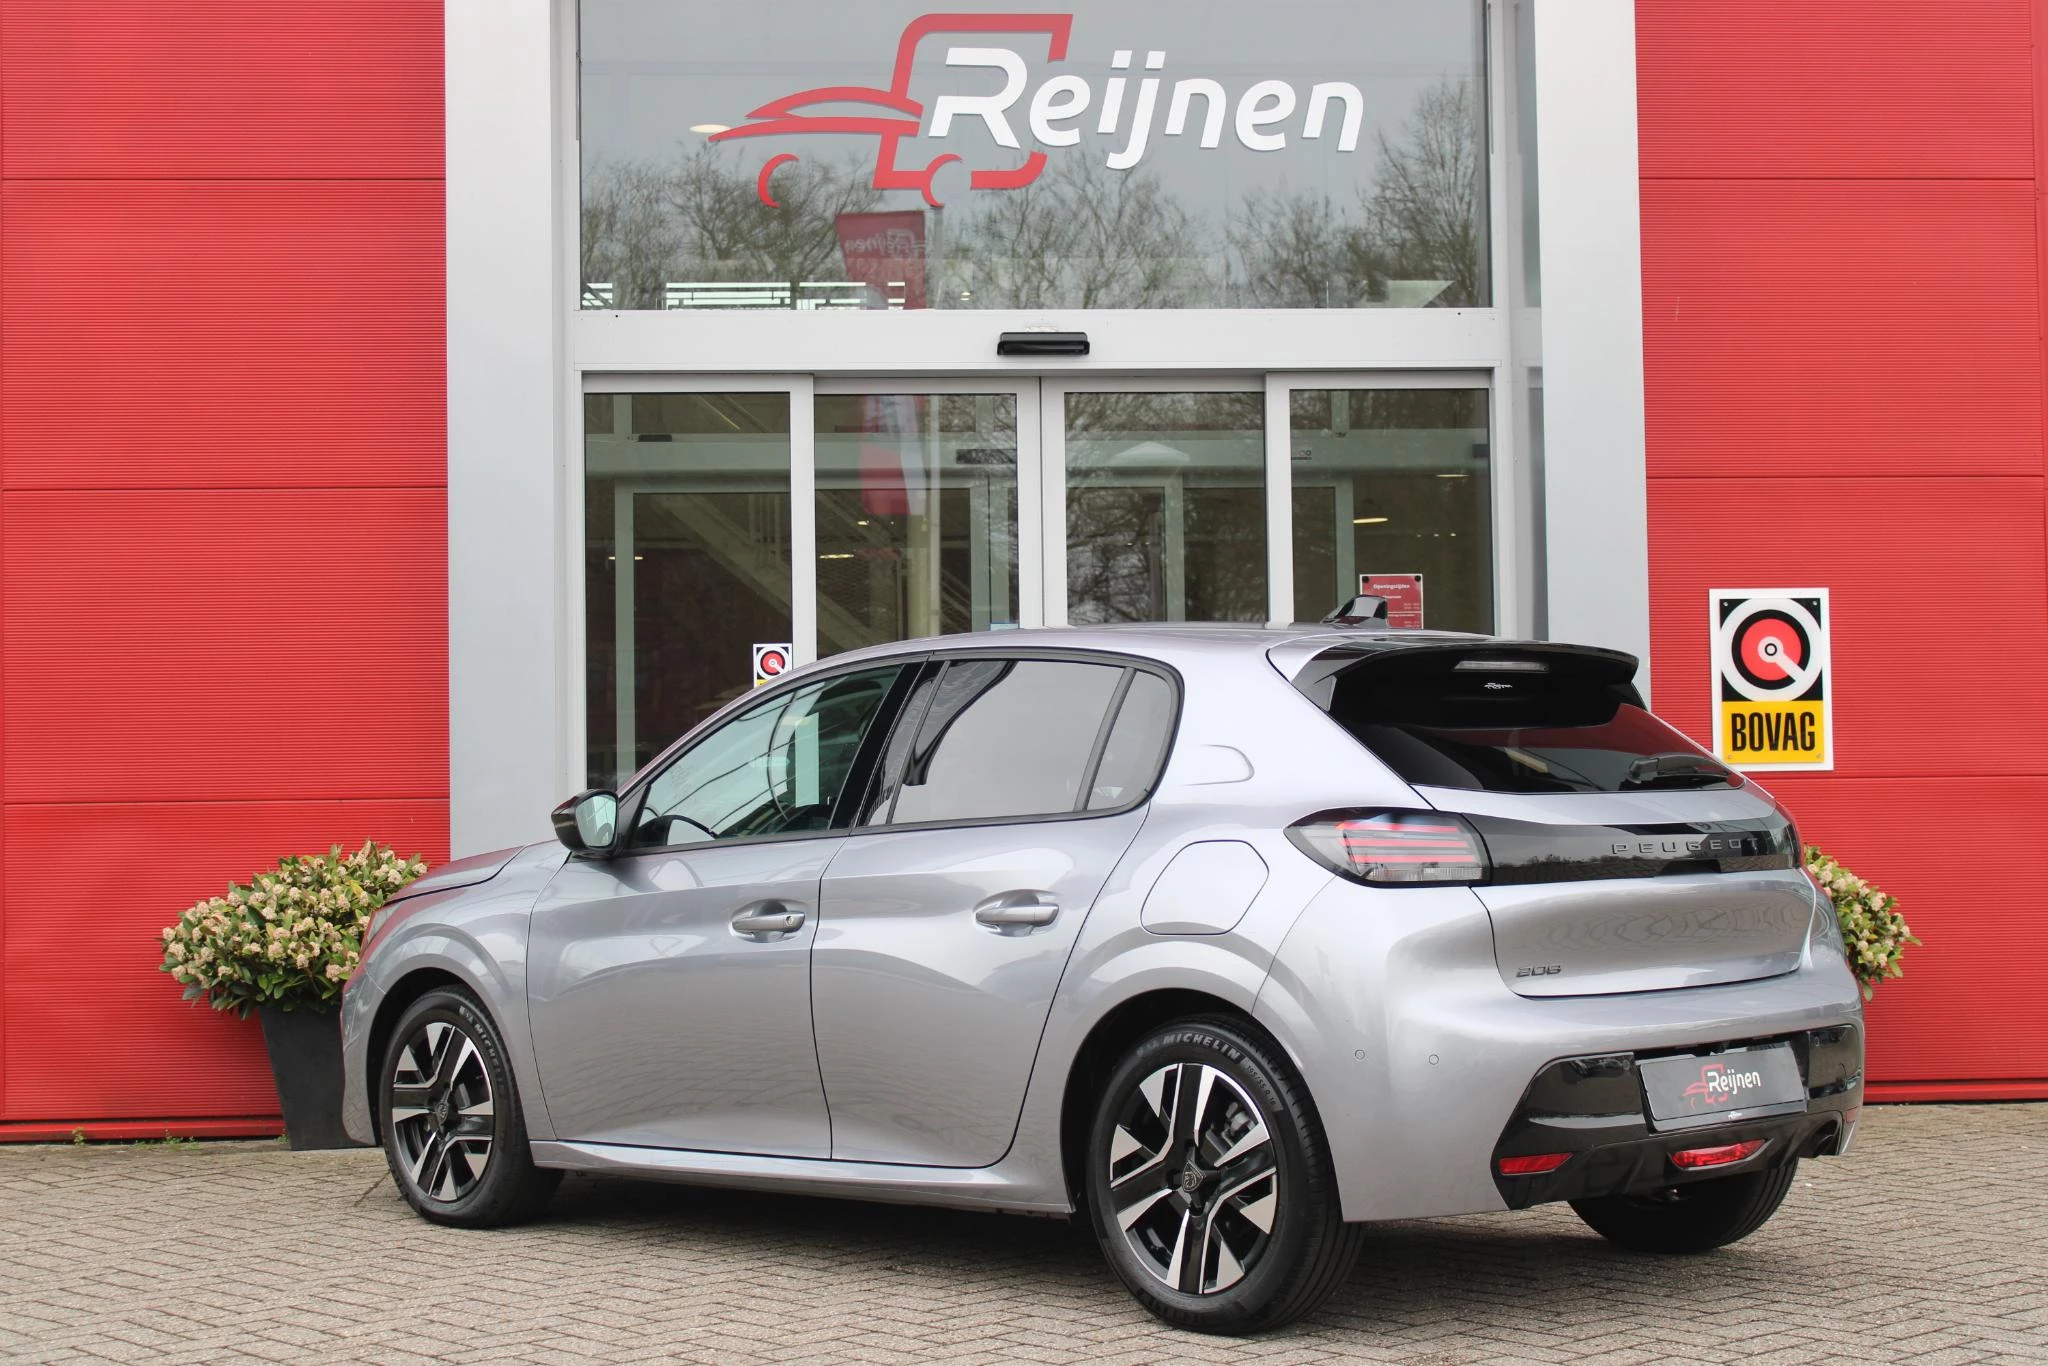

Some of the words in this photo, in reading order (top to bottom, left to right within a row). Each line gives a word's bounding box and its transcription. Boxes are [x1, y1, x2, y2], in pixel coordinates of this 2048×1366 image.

[928, 47, 1364, 170] Reijnen
[1731, 711, 1815, 752] BOVAG
[1611, 837, 1758, 855] PEUGEOT
[1163, 1033, 1241, 1060] MICHELIN
[1707, 1069, 1761, 1095] Reijnen
